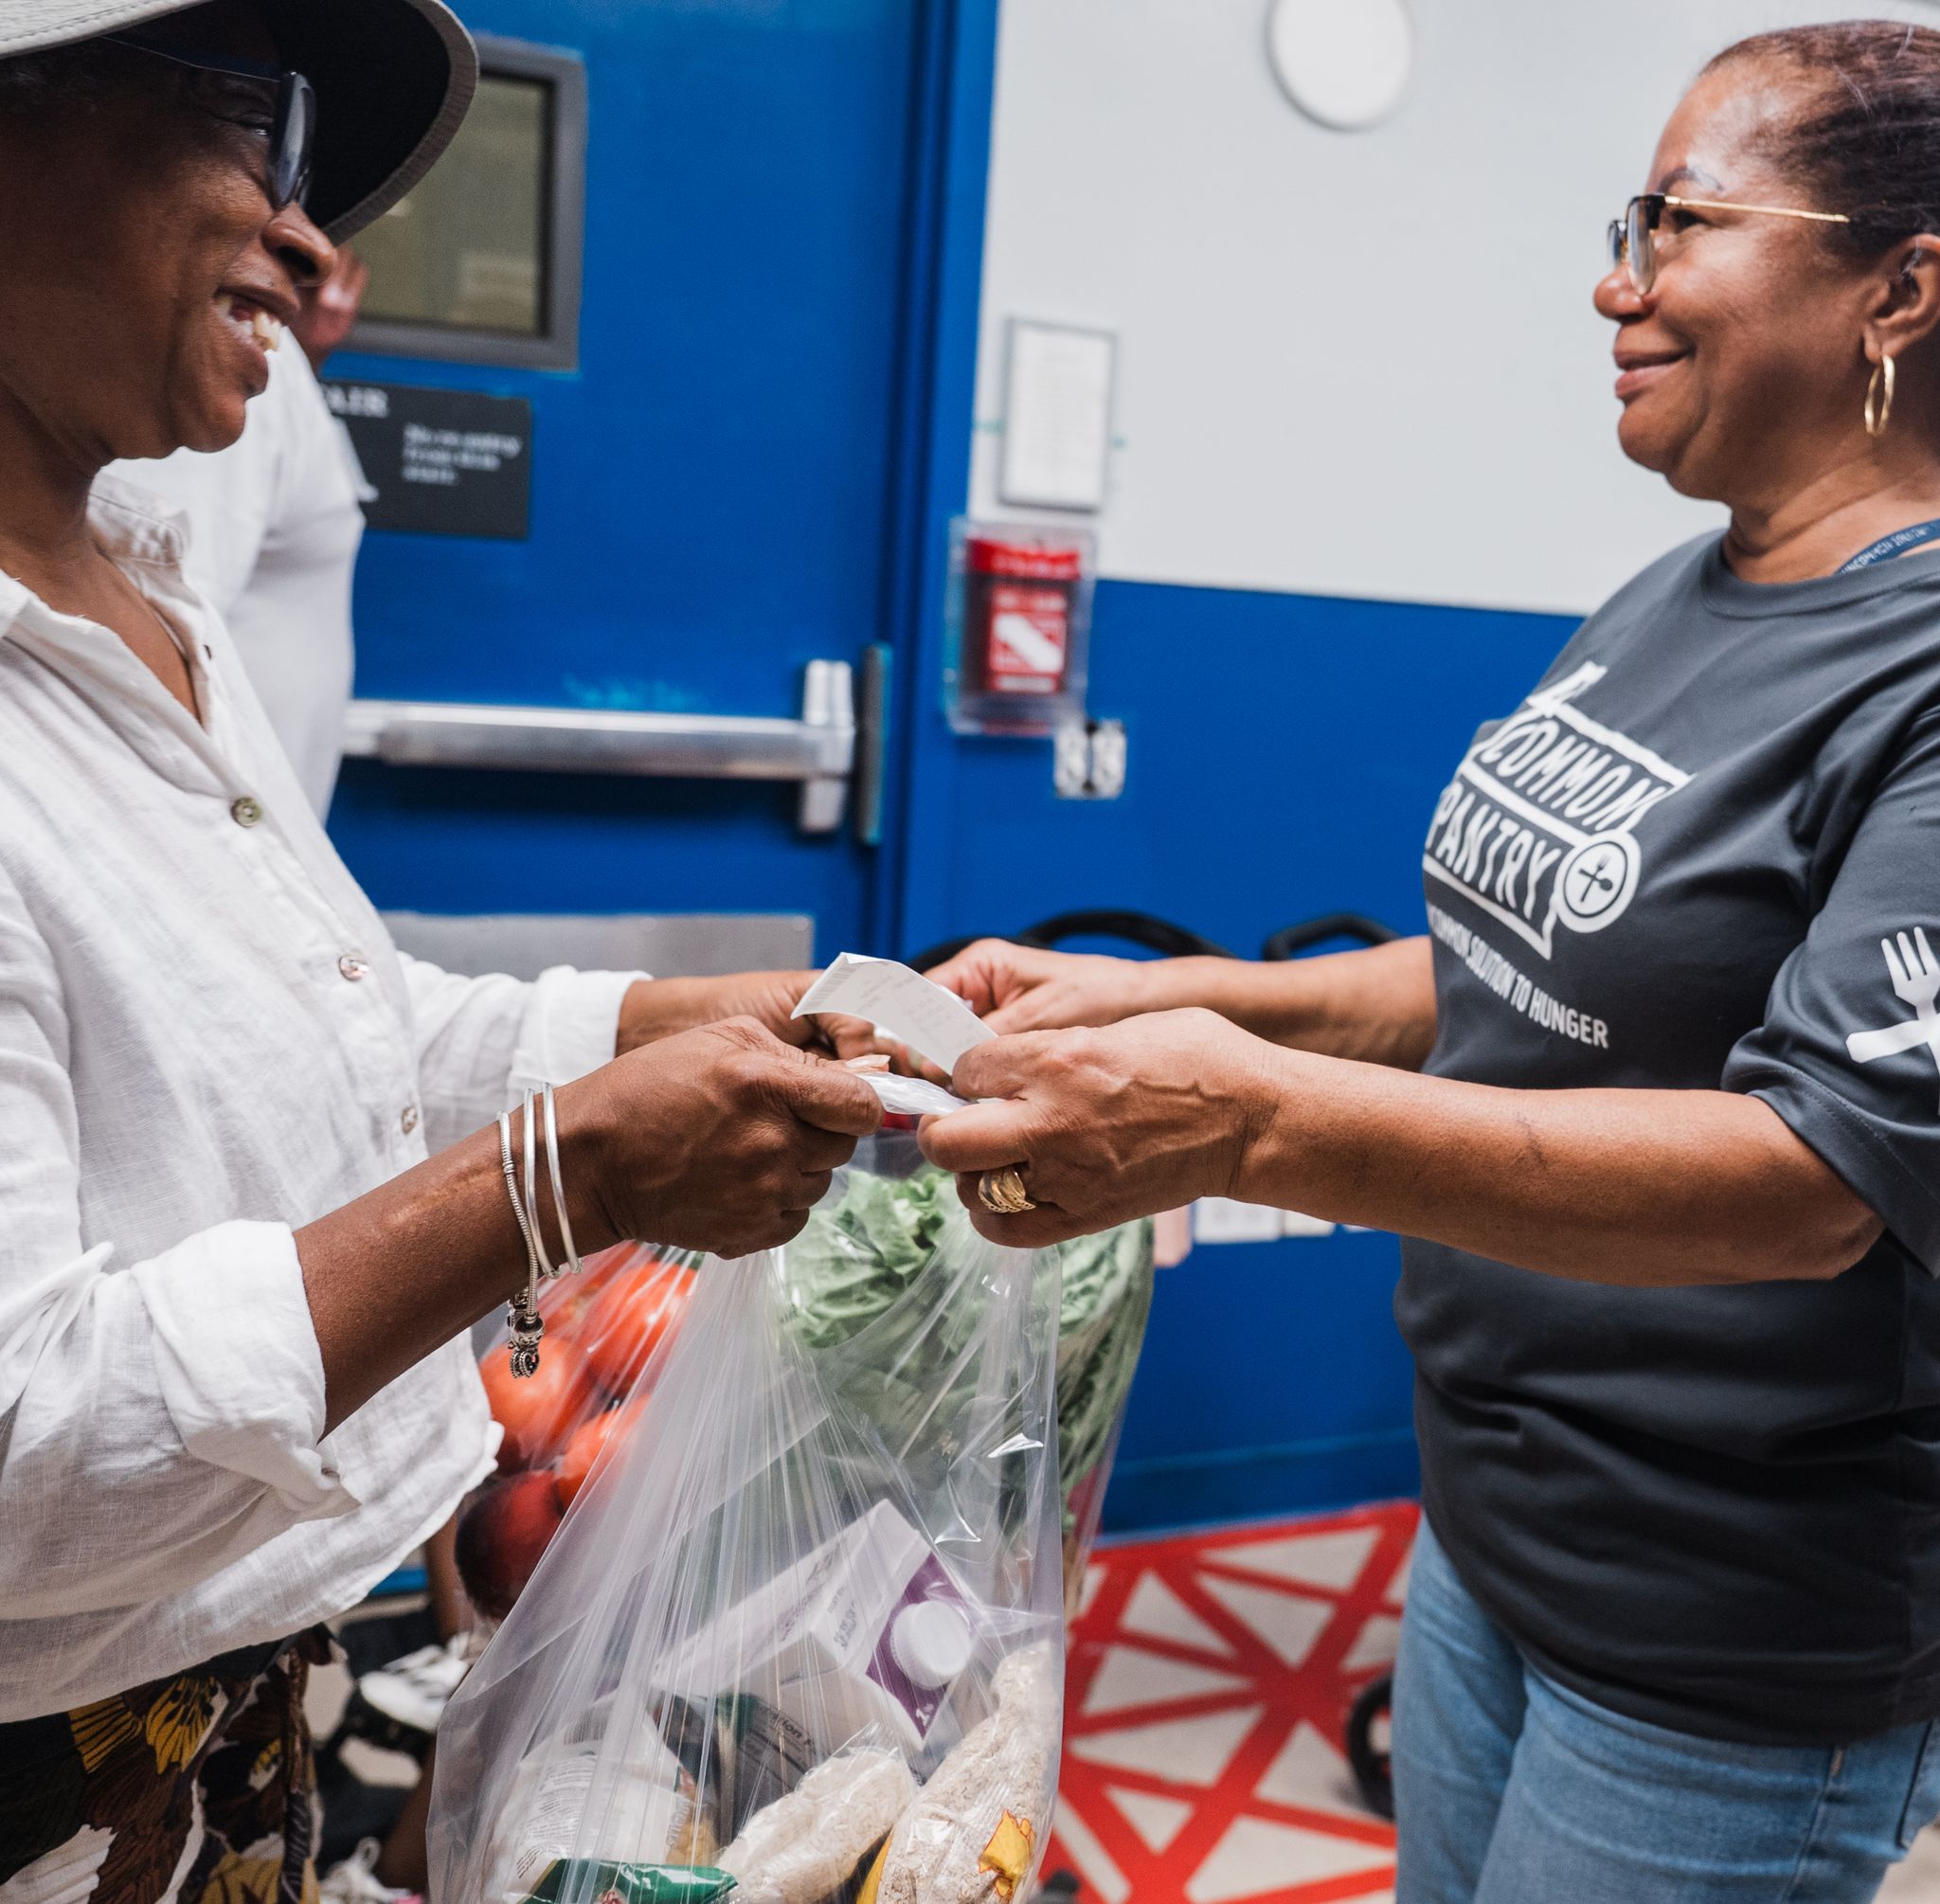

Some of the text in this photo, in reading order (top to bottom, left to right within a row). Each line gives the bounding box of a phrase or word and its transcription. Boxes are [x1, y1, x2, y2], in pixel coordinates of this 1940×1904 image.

[1481, 720, 1667, 832] COMMON
[1425, 781, 1562, 920] PANTRY
[1465, 934, 1518, 1000] SOLUTION
[1510, 973, 1542, 1013] TO
[1528, 986, 1609, 1049] HUNGER
